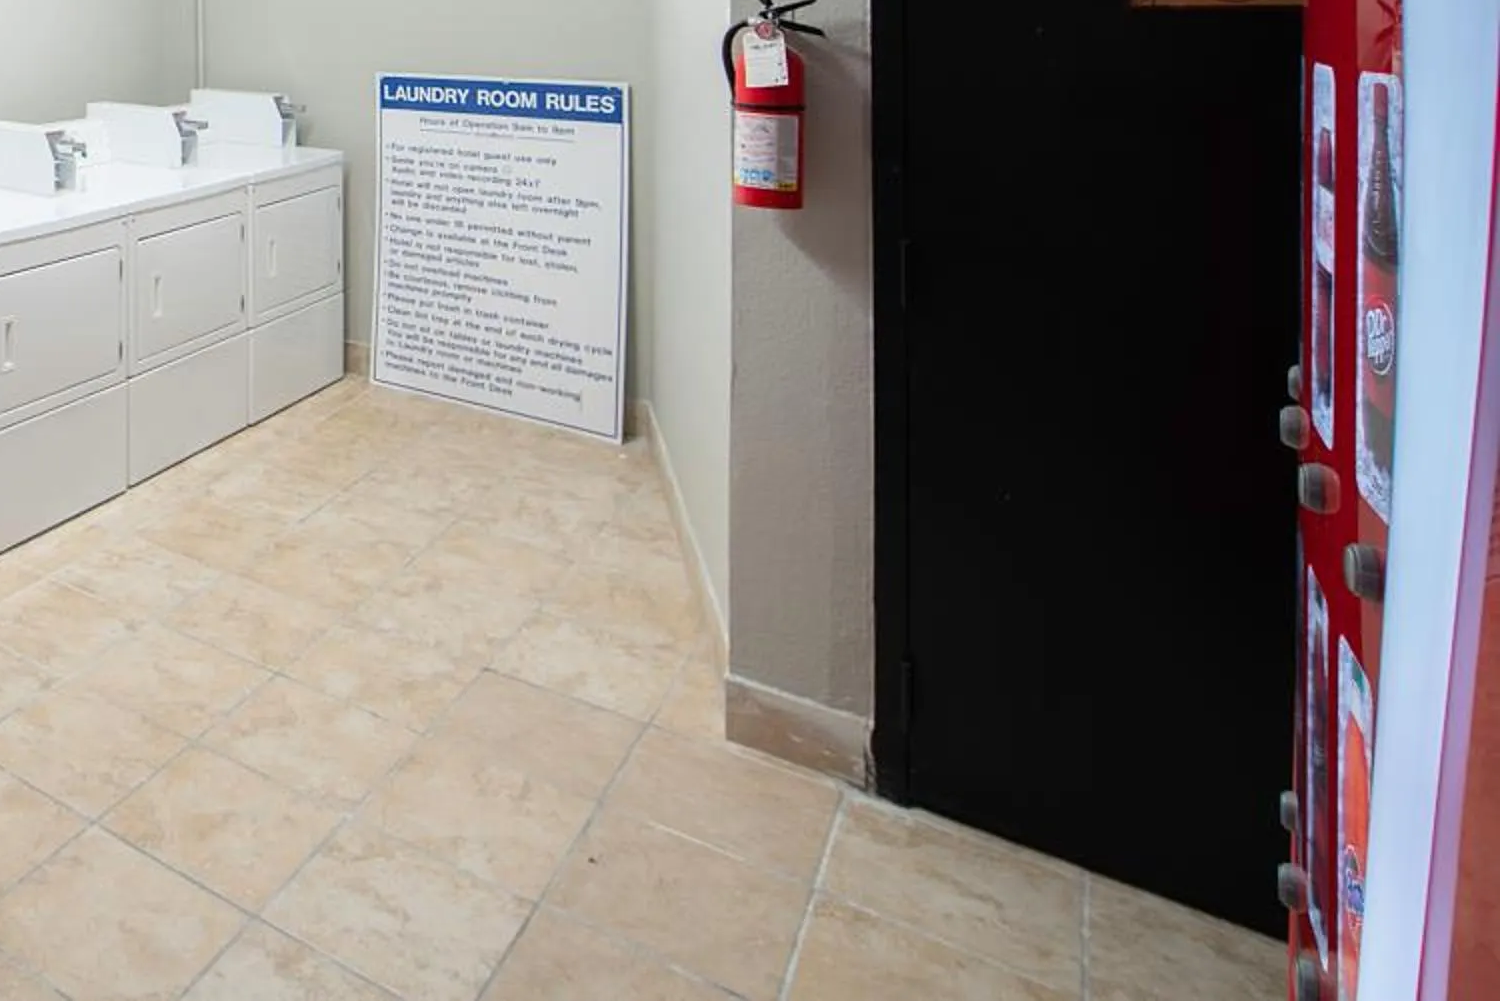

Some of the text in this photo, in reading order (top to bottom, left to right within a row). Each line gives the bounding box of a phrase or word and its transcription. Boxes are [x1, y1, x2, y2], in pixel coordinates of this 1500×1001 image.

[384, 84, 614, 112] LAUNDRY ROOM RULES
[462, 120, 508, 131] Operation
[407, 144, 453, 156] registered
[457, 148, 480, 157] hotel
[483, 150, 510, 161] guest
[514, 154, 532, 162] use
[536, 155, 556, 165] only
[463, 163, 497, 172] camera
[467, 173, 510, 185] recording
[452, 186, 474, 195] open
[547, 195, 570, 204] after
[422, 201, 466, 214] discarded
[445, 195, 484, 207] anything
[531, 205, 578, 218] overnight
[389, 224, 421, 237] Change
[437, 231, 475, 243] available
[493, 239, 508, 248] the
[513, 241, 537, 252] Front
[542, 245, 566, 256] Desk
[468, 222, 512, 236] permitted
[517, 228, 552, 240] without
[557, 233, 590, 246] parent
[402, 249, 441, 262] damaged
[444, 245, 497, 261] responsible
[501, 253, 514, 262] for
[454, 283, 486, 294] remove
[533, 294, 556, 306] from
[387, 305, 410, 317] Clean
[465, 320, 480, 330] the
[484, 323, 502, 334] end
[520, 330, 544, 342] each
[548, 336, 580, 351] drying
[584, 342, 611, 357] cycle
[493, 350, 506, 359] for
[417, 358, 443, 371] report
[447, 364, 490, 382] damaged
